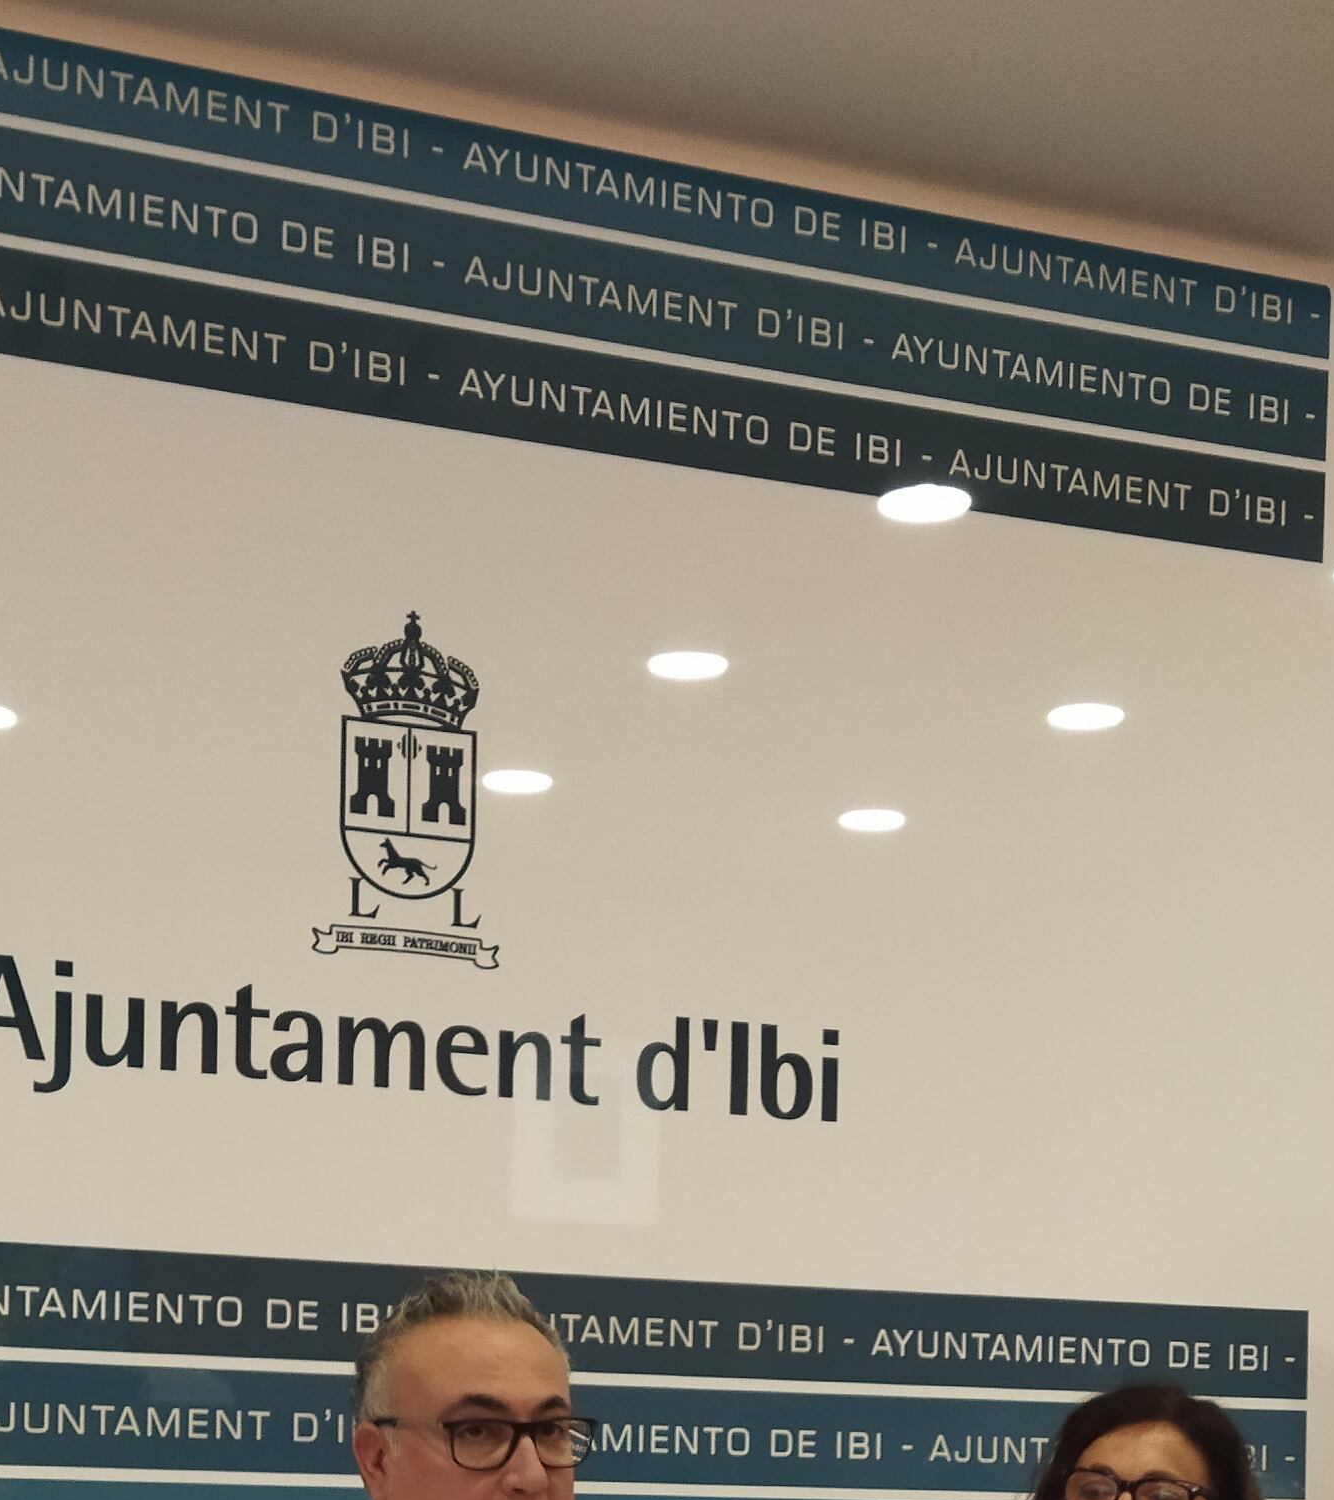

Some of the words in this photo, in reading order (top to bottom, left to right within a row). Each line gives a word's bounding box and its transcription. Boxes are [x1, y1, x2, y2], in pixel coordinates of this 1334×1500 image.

[313, 110, 409, 159] D'IBI
[463, 142, 774, 229] AYUNTAMIENTO
[794, 205, 841, 242] DE
[861, 218, 906, 254] IBI
[954, 238, 1198, 307] AJUNTAMENT
[1215, 285, 1293, 325] D'IBI
[281, 220, 334, 259] DE
[357, 233, 409, 273] IBI
[464, 256, 738, 330] AJUNTAMENT
[757, 308, 843, 350] D'IBI
[891, 333, 1171, 406] AYUNTAMIENTO
[1189, 382, 1231, 416] DE
[1249, 392, 1289, 426] IBI
[309, 340, 405, 386] D'IBI
[459, 368, 769, 446] AYUNTAMIENTO
[789, 421, 836, 457] DE
[855, 432, 901, 467] IBI
[949, 448, 1192, 511] AJUNTAMENT
[1209, 488, 1286, 527] D'IBI
[636, 1016, 839, 1123] d'Ibi
[266, 1298, 319, 1331] DE
[738, 1319, 823, 1353] D'IBI
[871, 1328, 1150, 1367] AYUNTAMIENTO
[1168, 1341, 1211, 1370] DE
[1229, 1343, 1269, 1372] IBI
[770, 1429, 817, 1458] DE
[836, 1431, 881, 1460] IBI
